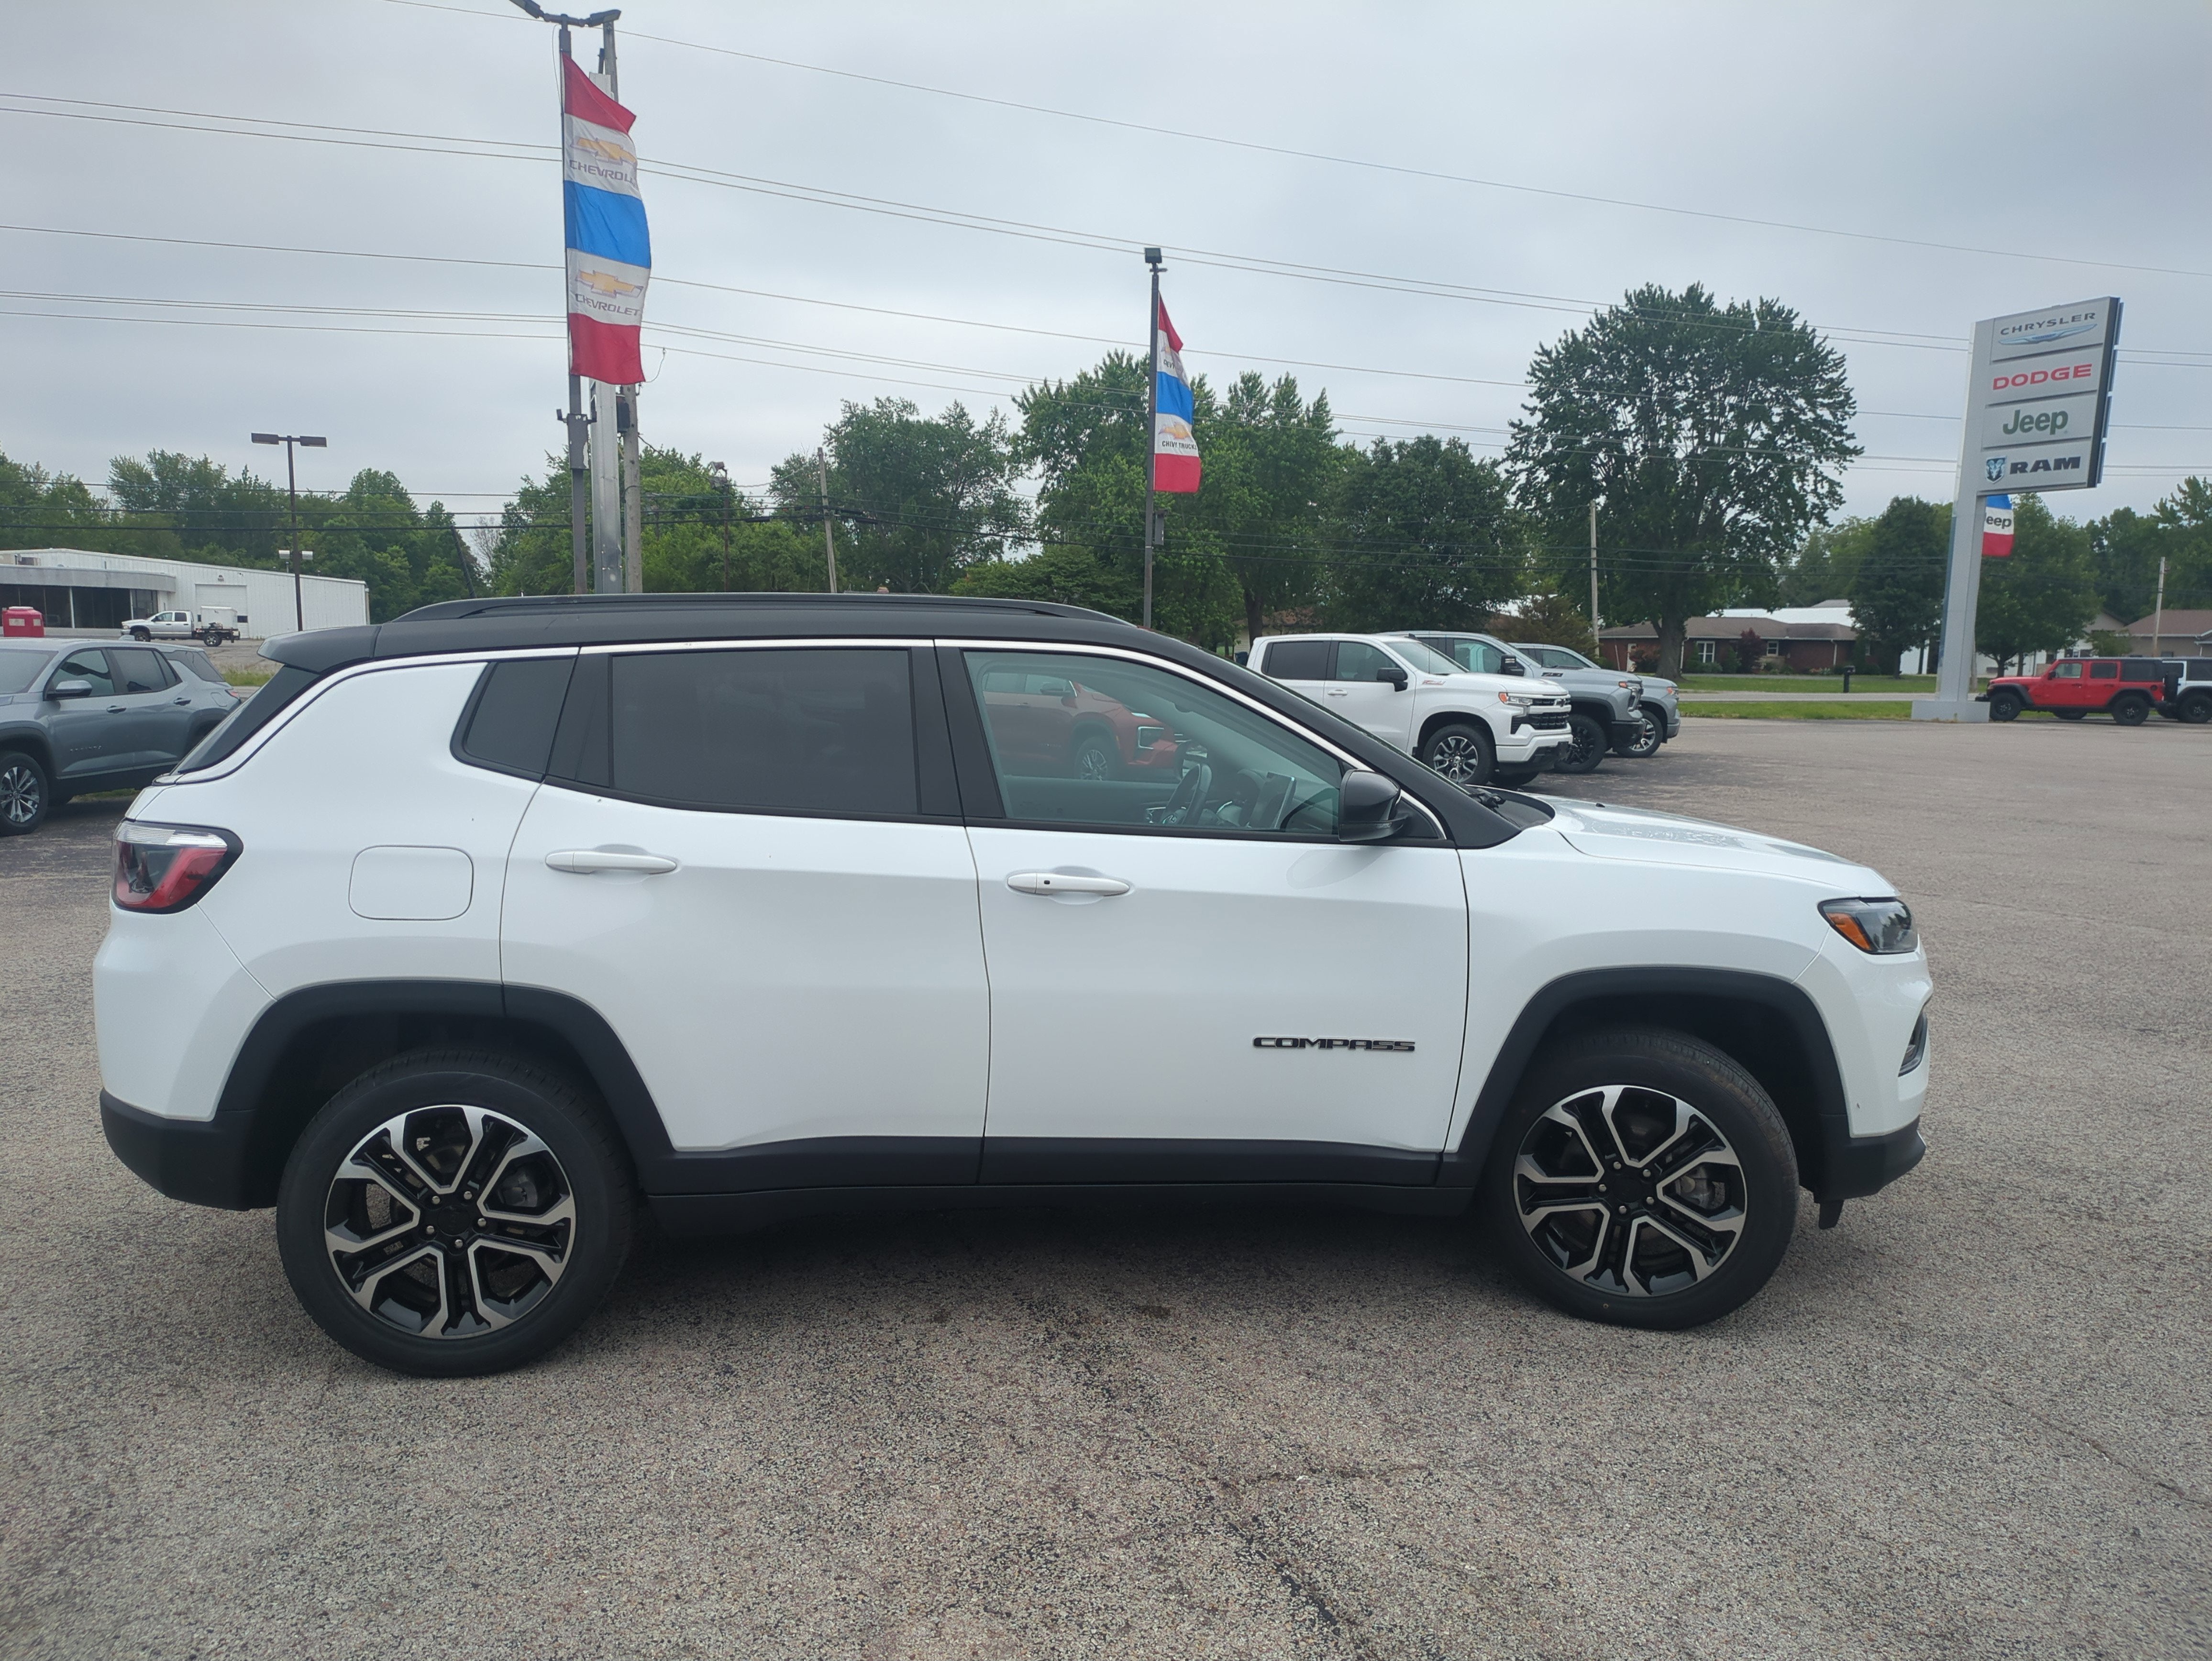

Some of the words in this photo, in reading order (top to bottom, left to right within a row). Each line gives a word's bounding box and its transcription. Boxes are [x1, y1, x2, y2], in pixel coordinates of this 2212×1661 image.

[575, 293, 642, 316] CHEVROLET
[2000, 312, 2095, 335] CHRYSLER
[1992, 364, 2092, 390] DODGE
[2002, 410, 2068, 435] Jeep
[2010, 456, 2081, 475] RAM
[1986, 516, 2012, 529] eep
[1252, 1037, 1415, 1052] COMPASS
